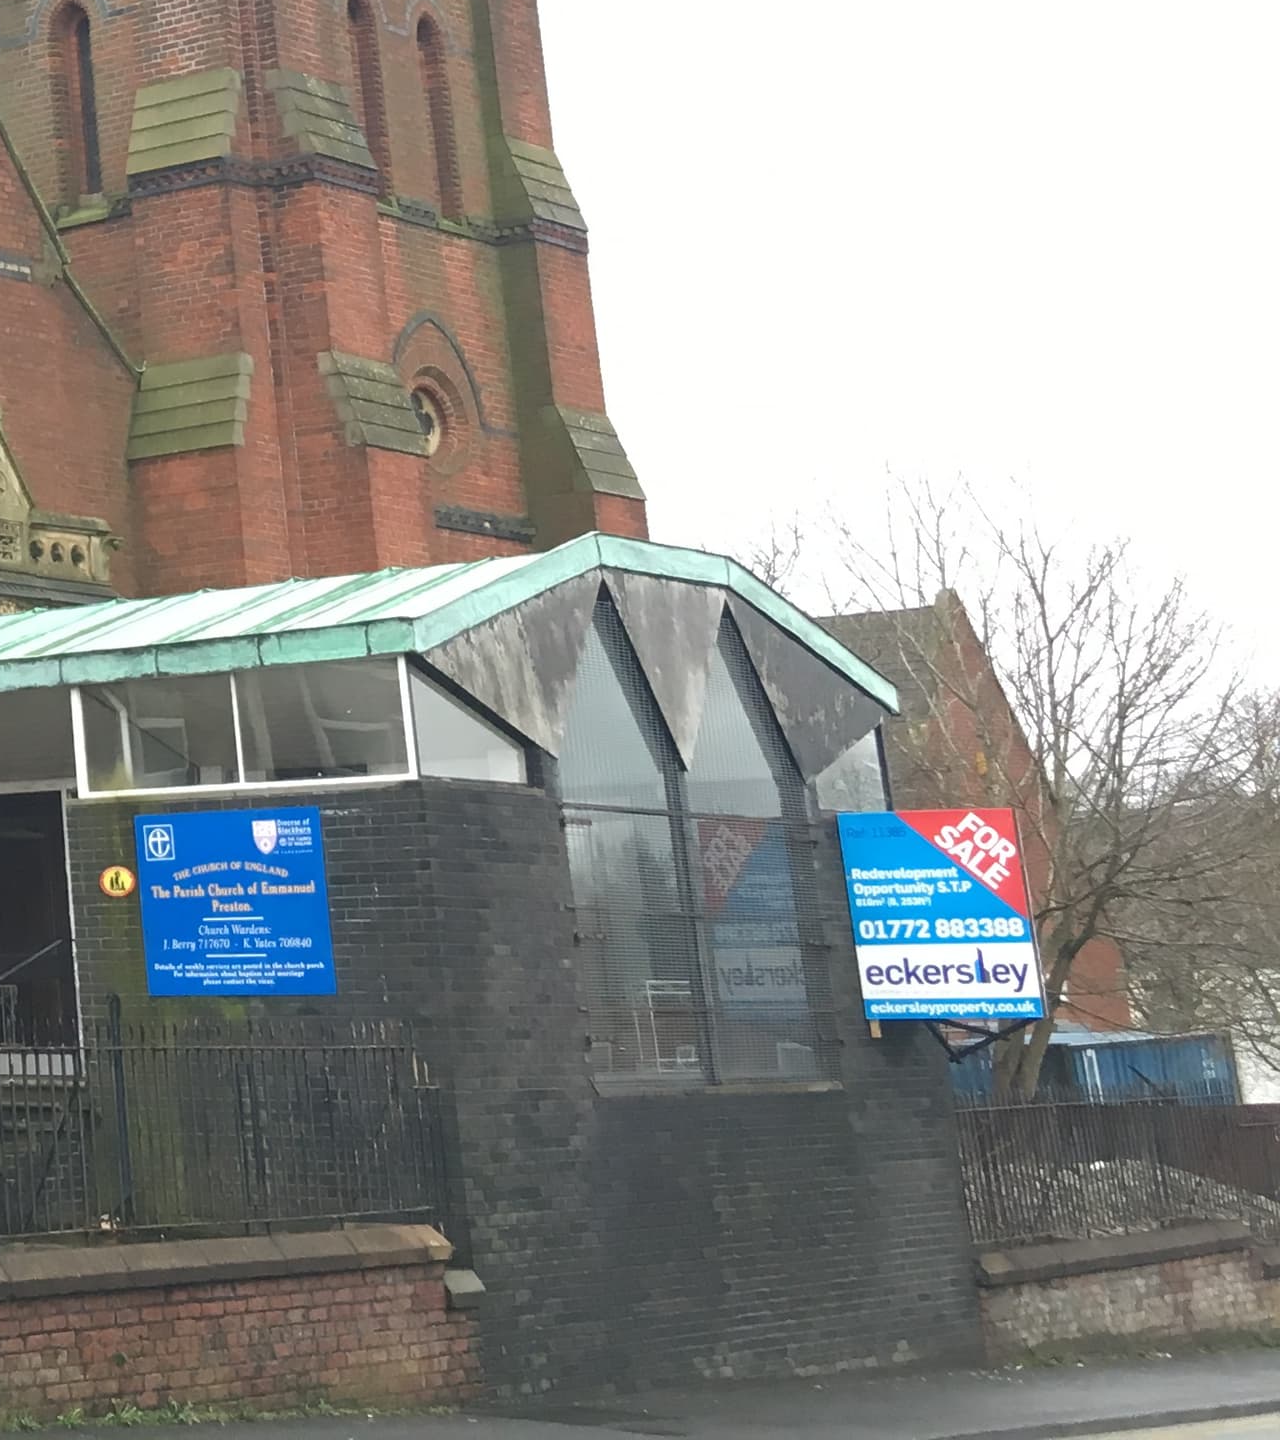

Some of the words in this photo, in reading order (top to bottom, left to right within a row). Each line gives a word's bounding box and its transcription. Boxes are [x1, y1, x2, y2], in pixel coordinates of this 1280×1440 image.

[956, 812, 1016, 866] FOR
[934, 825, 1011, 890] SALE
[173, 869, 191, 881] THE
[192, 861, 228, 875] CHURCH
[230, 861, 242, 870] OF
[245, 861, 289, 878] ENGLAND
[851, 867, 958, 881] Redevelopment
[151, 885, 171, 899] The
[174, 883, 205, 898] Parish
[208, 882, 244, 897] Church
[247, 881, 258, 895] of
[261, 880, 315, 895] Emmanuel
[853, 882, 934, 898] Opportunity
[937, 881, 972, 893] S.T.P
[211, 899, 254, 912] Preston.
[198, 924, 229, 936] Church
[231, 924, 271, 935] Wardens:
[859, 919, 931, 939] 01772
[935, 917, 1025, 939] 883388
[172, 939, 196, 951] Berry
[255, 938, 276, 948] Yates
[284, 961, 305, 969] church
[866, 947, 1028, 993] eckersley
[870, 1000, 1037, 1016] eckersleyproperty.co.uk
